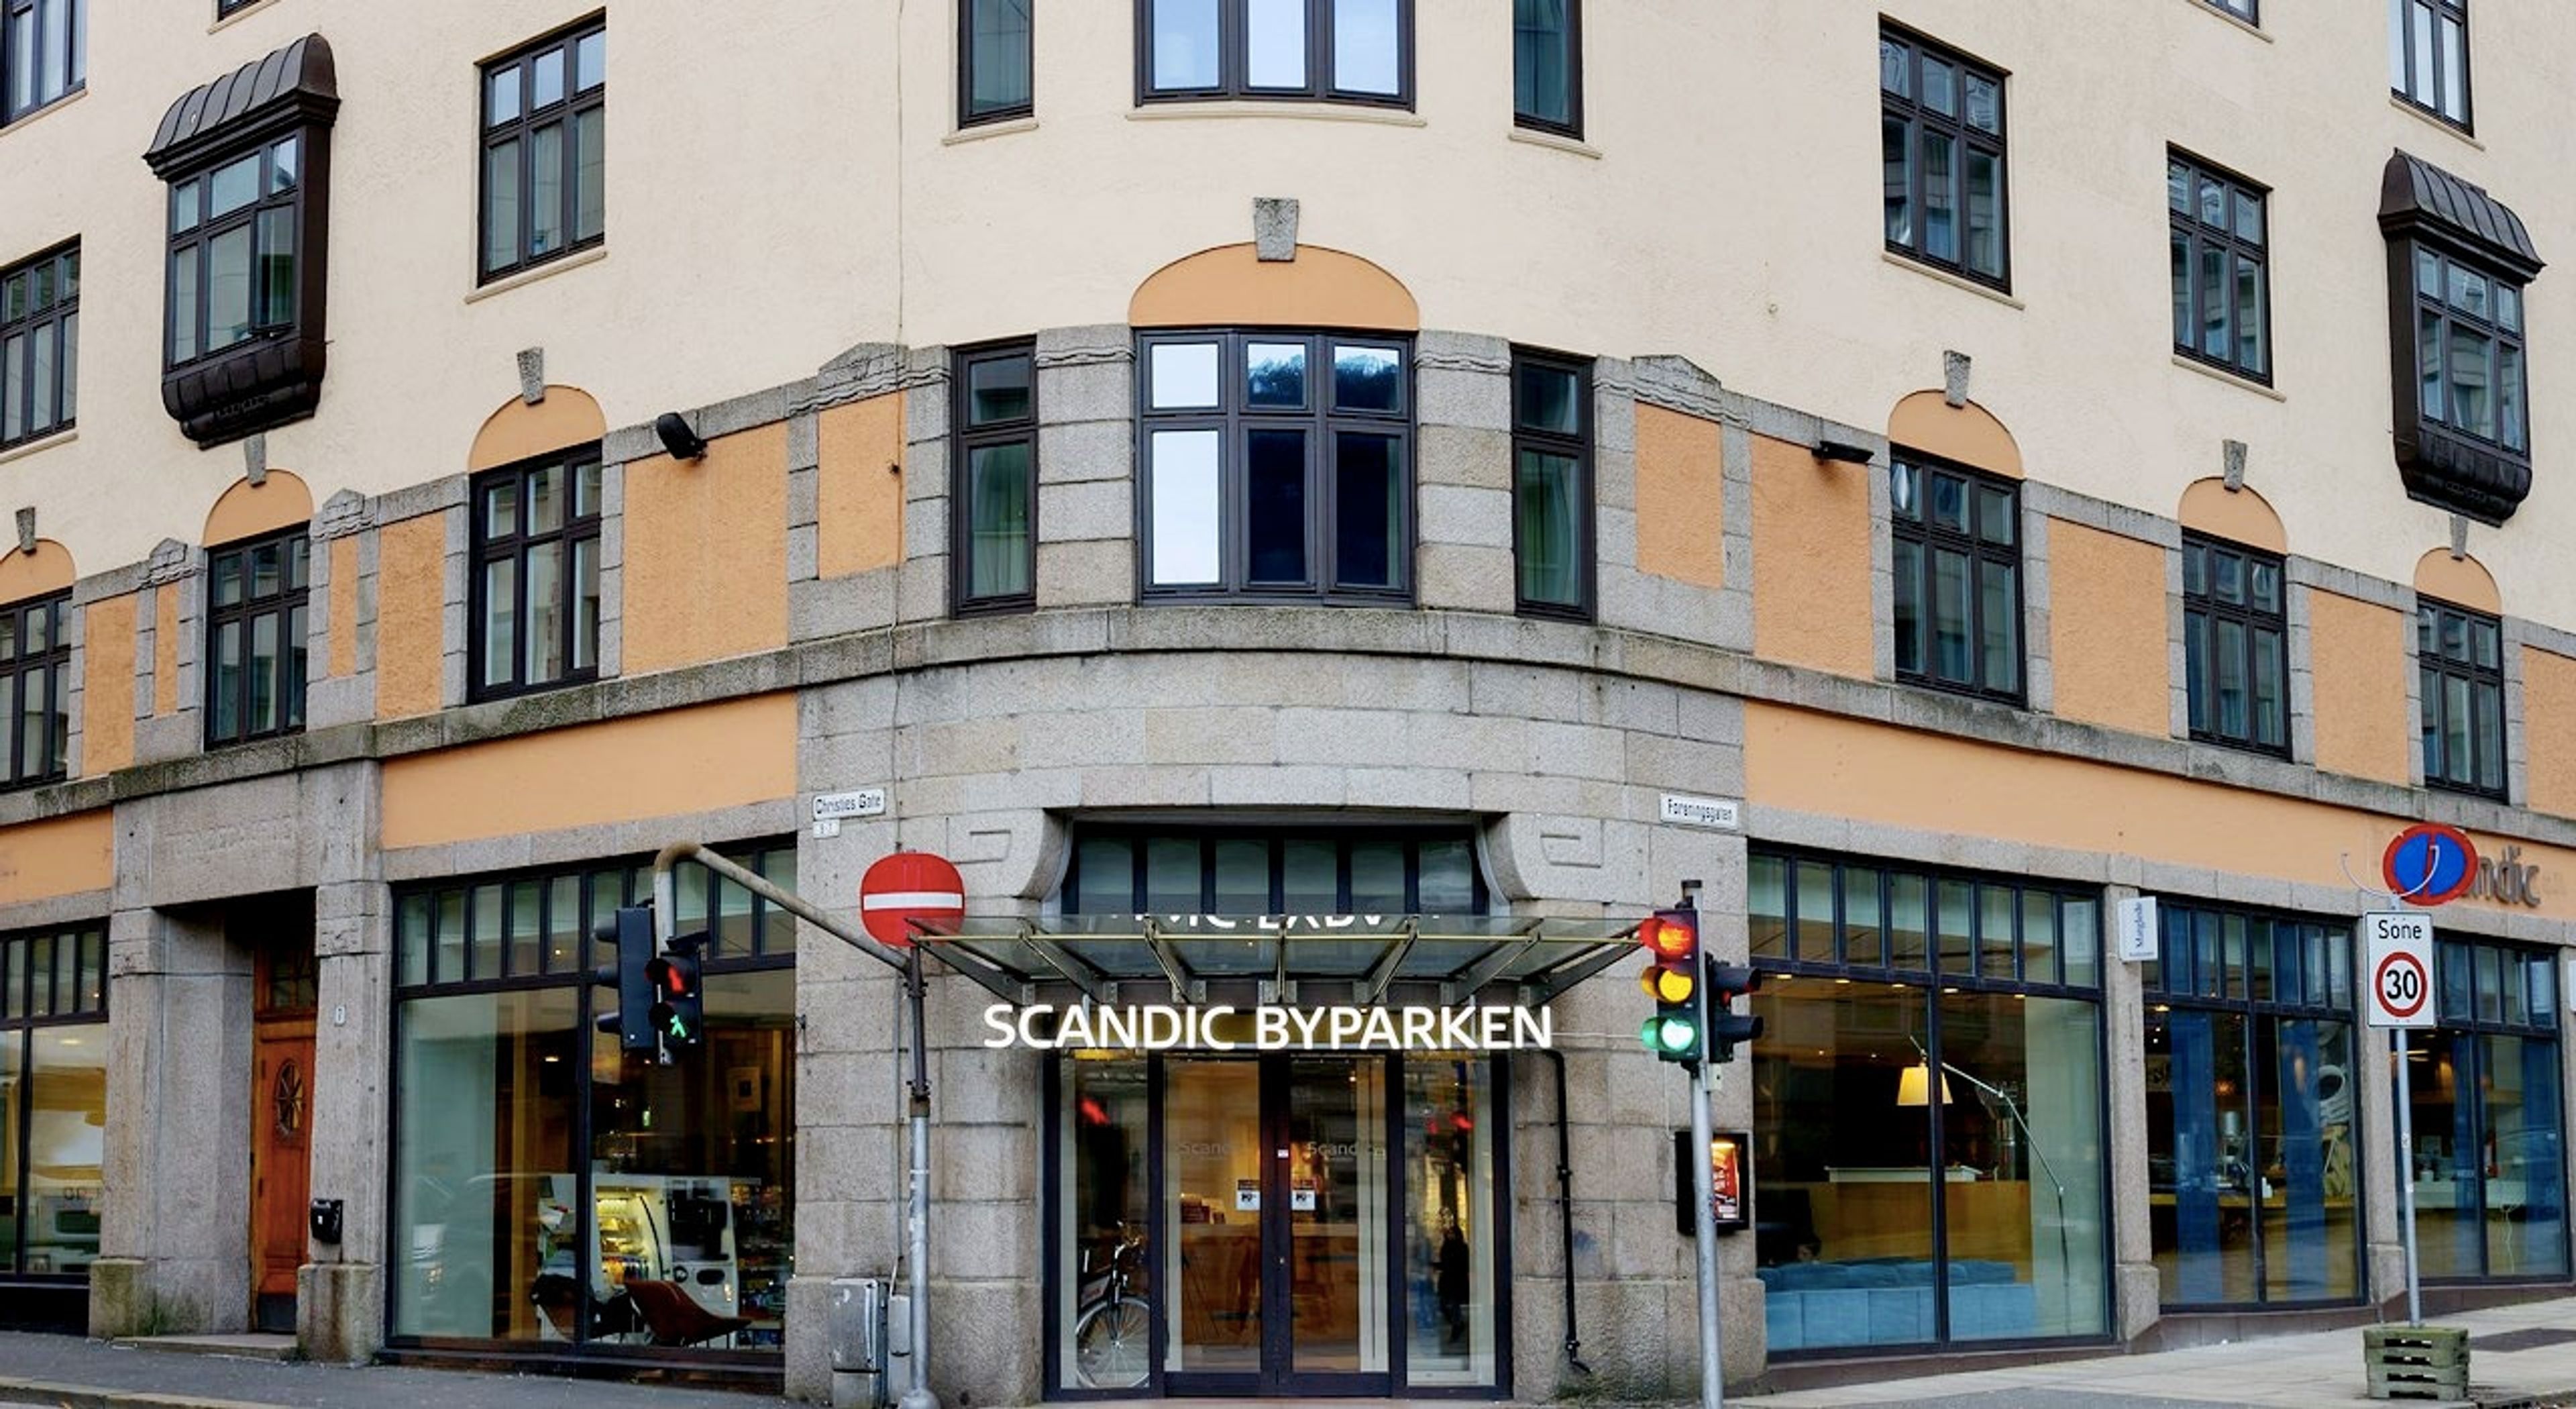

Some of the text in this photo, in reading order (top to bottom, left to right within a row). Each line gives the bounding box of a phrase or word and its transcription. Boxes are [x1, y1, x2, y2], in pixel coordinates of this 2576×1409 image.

[816, 793, 881, 814] Christies Gate
[1667, 798, 1732, 823] Foreningsgaten
[2461, 844, 2541, 908] ndic
[2377, 919, 2423, 939] Sone
[2385, 970, 2418, 1000] 30
[984, 1004, 1552, 1049] SCANDIC BYPARKEN
